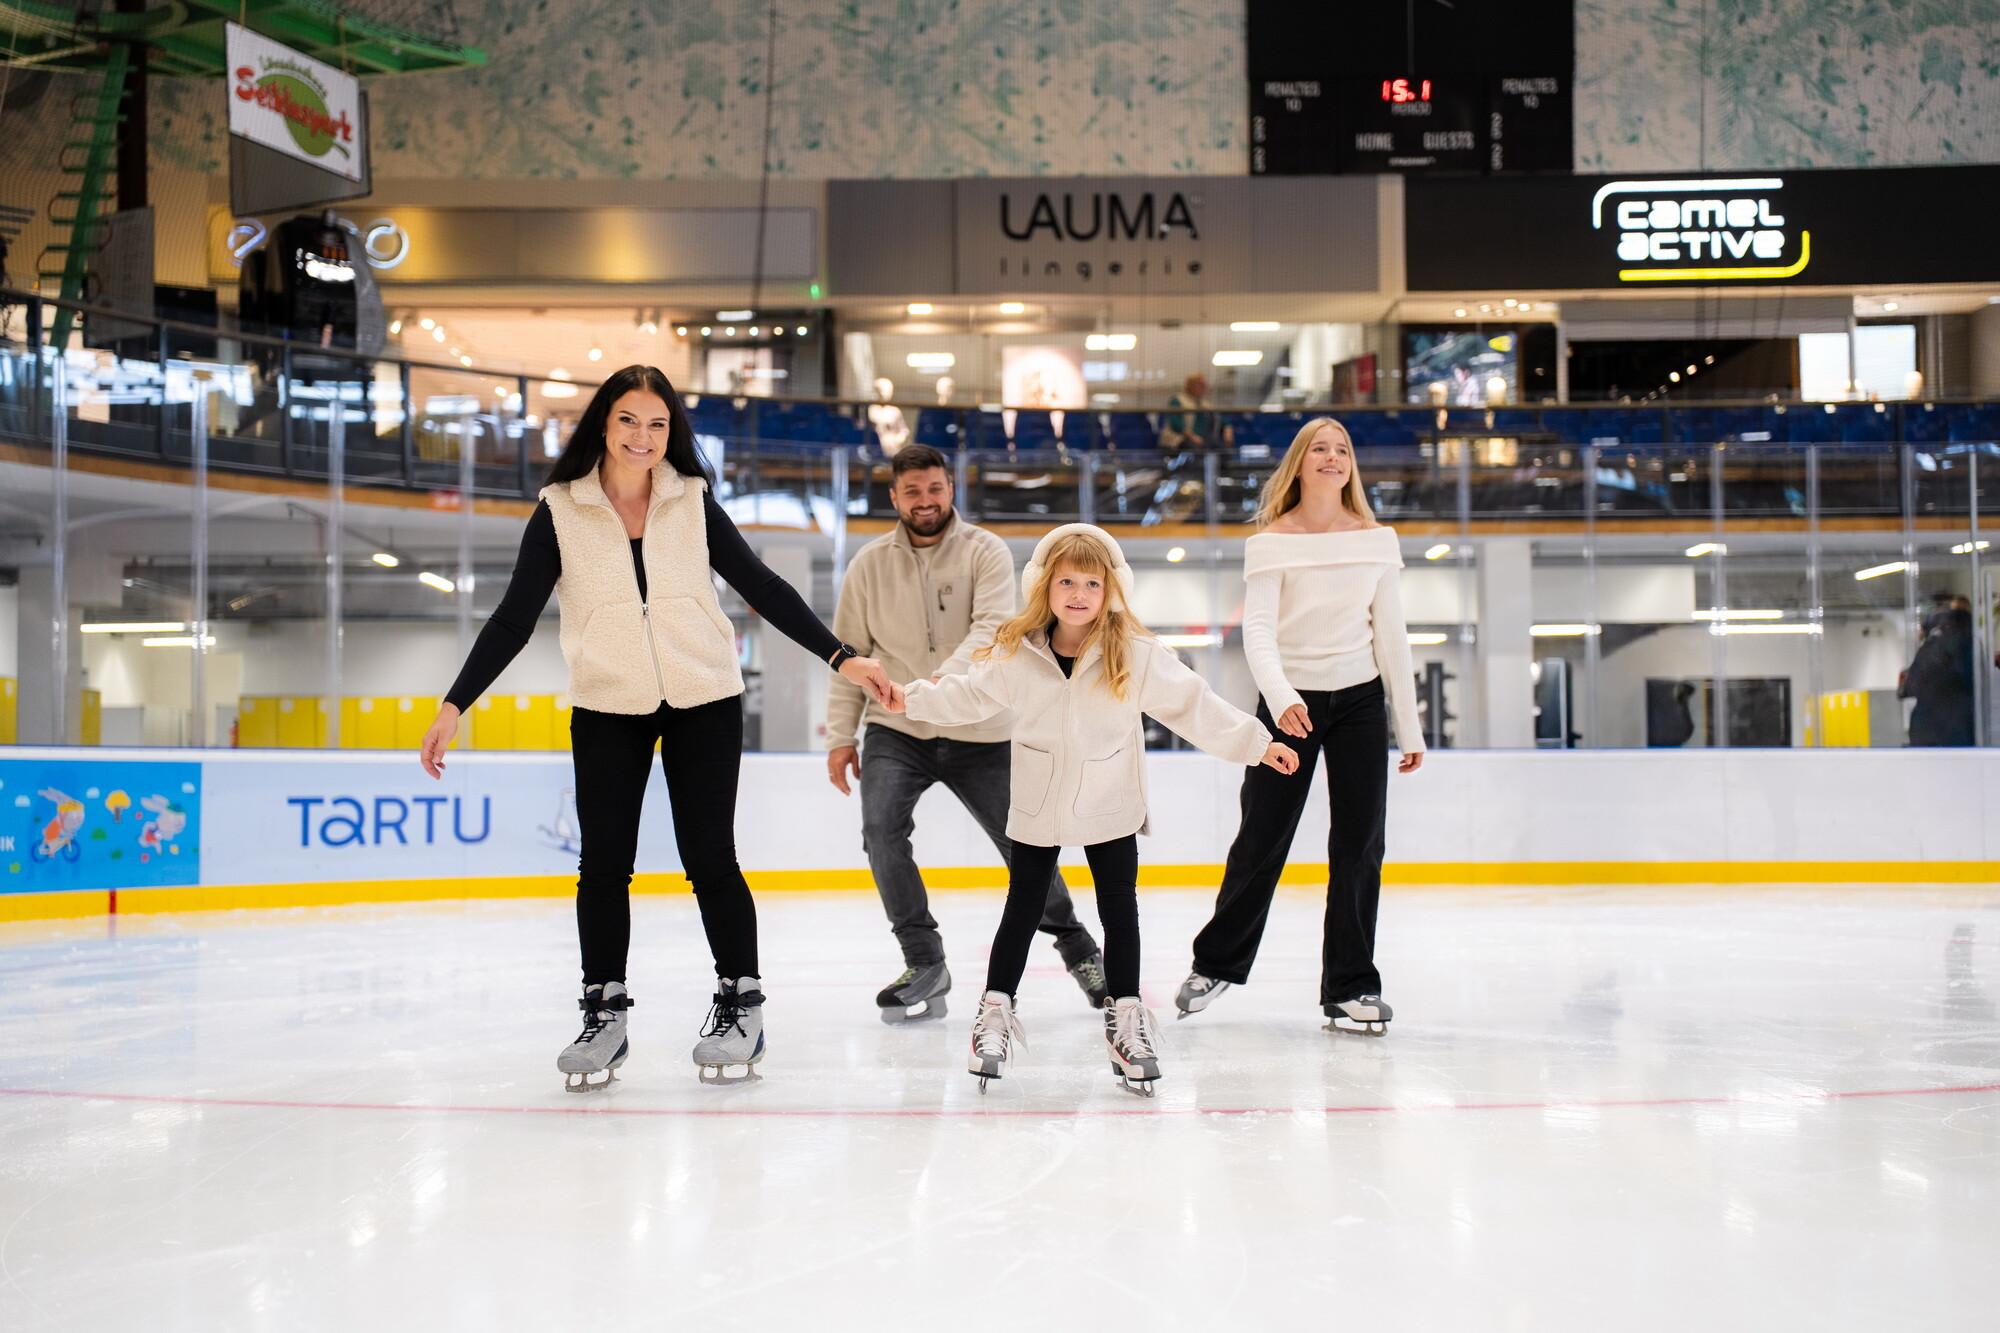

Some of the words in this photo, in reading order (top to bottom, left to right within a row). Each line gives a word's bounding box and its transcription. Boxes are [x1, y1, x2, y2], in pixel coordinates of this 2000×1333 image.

[1356, 133, 1394, 151] HOME
[1423, 131, 1475, 149] GUESTS
[1000, 193, 1199, 241] LAUMA
[1000, 257, 1202, 281] lingerie
